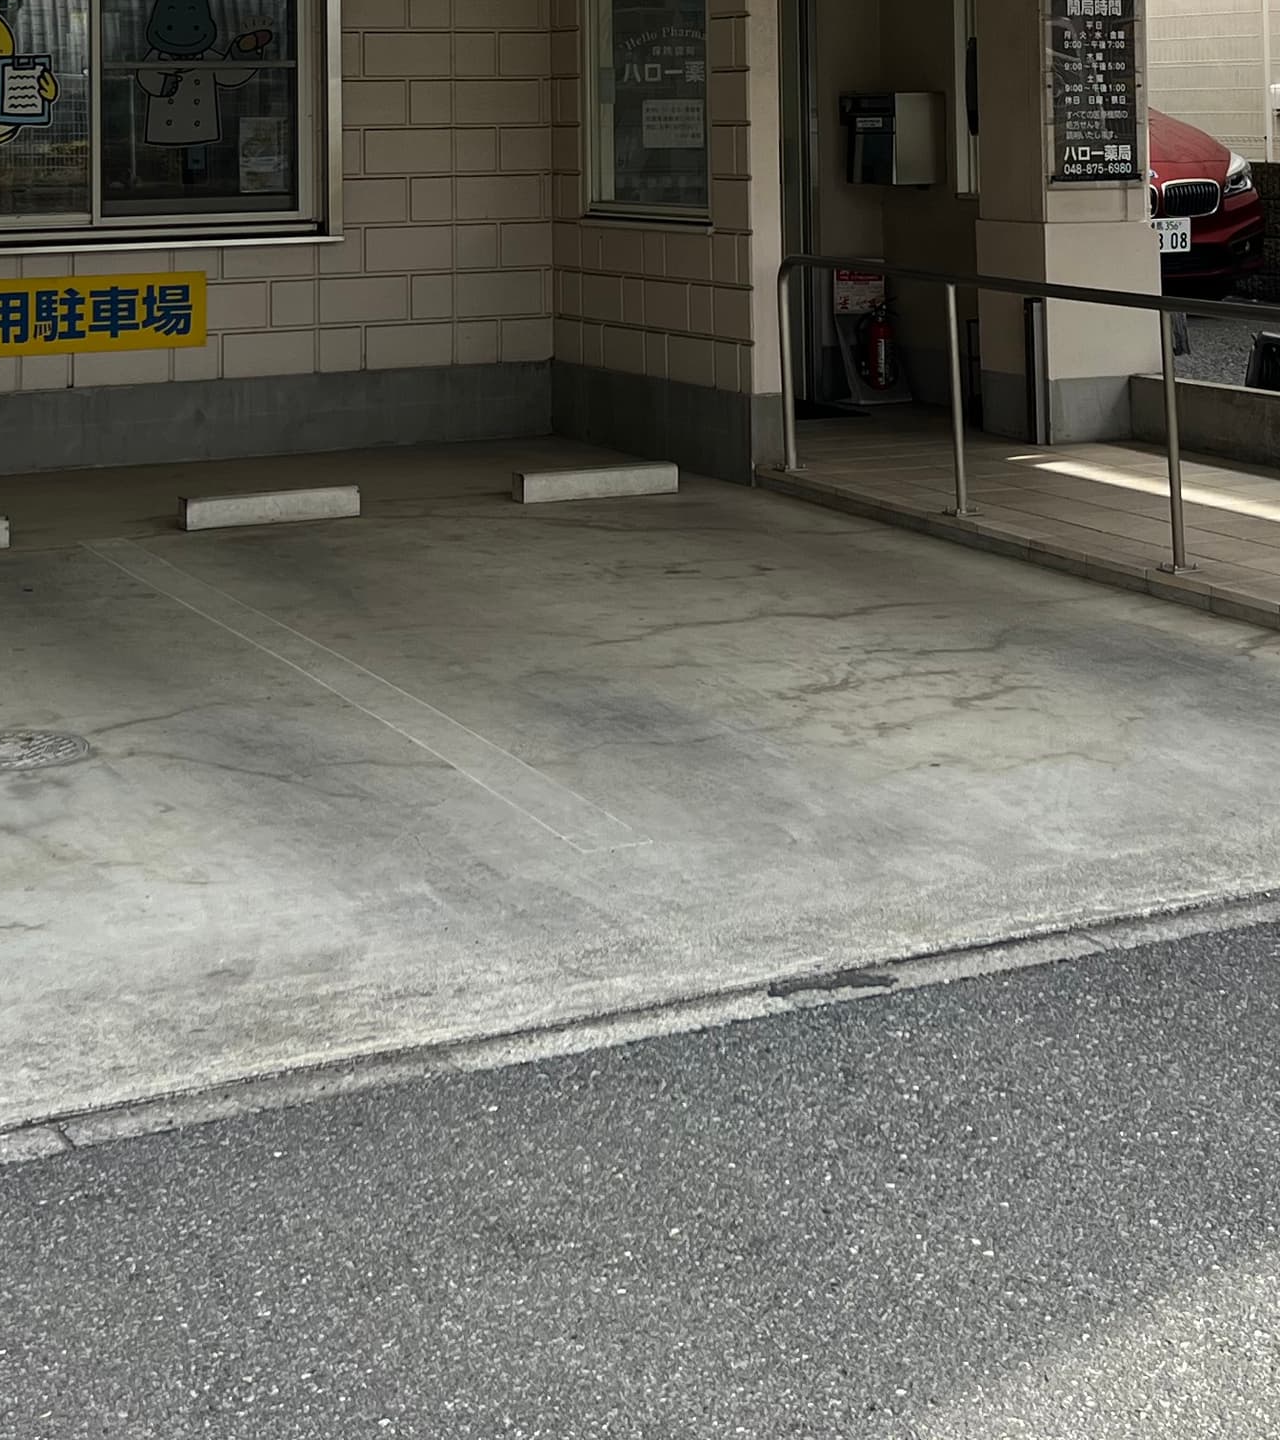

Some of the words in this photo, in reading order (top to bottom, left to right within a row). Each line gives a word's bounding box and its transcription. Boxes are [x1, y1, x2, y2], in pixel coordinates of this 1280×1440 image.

[1066, 0, 1122, 16] 開局時間
[624, 31, 657, 50] Hello
[1063, 145, 1132, 161] ハロー薬局
[1063, 162, 1132, 175] 048-875-6980
